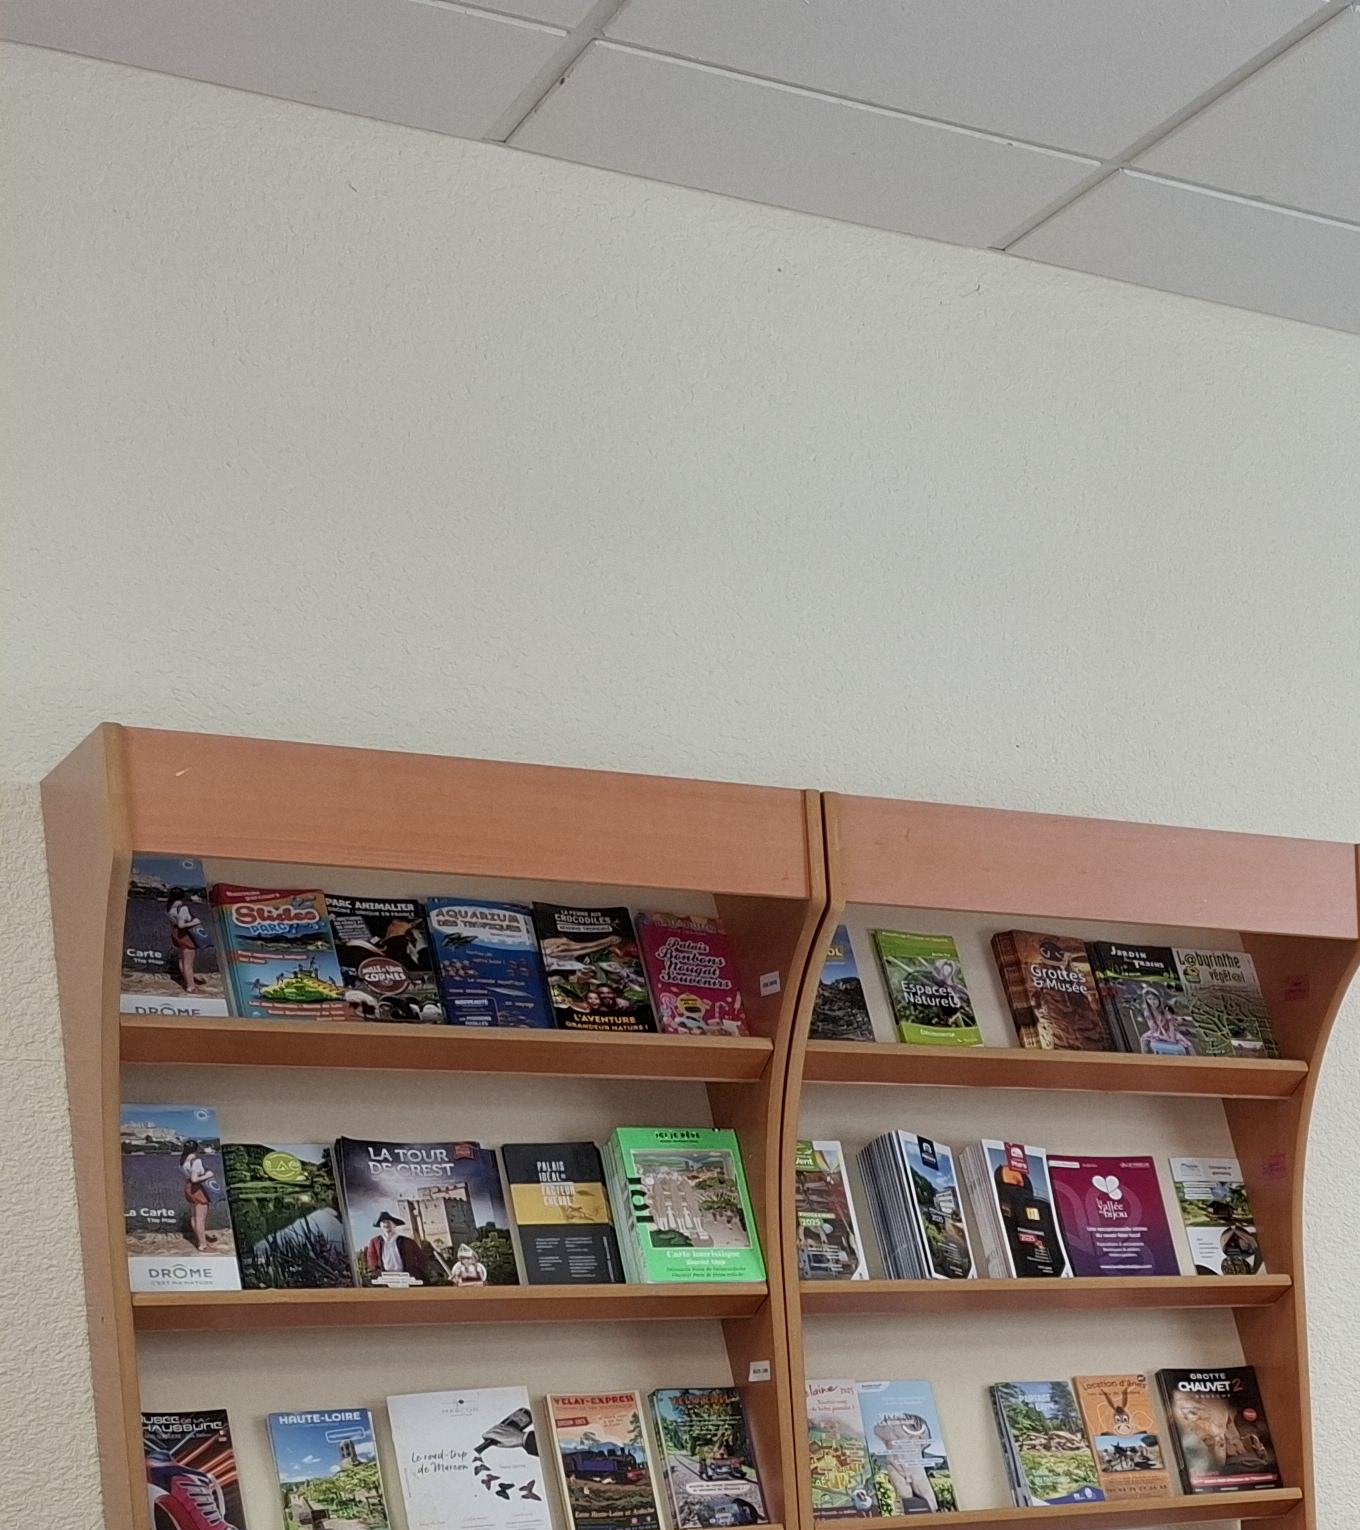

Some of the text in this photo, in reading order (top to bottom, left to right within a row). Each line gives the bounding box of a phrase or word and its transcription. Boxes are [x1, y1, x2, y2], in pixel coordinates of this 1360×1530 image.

[326, 898, 415, 912] PARC ANIMALIER
[234, 905, 319, 925] Slides
[435, 908, 521, 925] AQUARIUM
[554, 913, 612, 925] CROCODILES
[250, 923, 288, 935] PARC
[665, 937, 710, 954] Palais
[1110, 945, 1148, 960] JARDIN
[126, 948, 163, 959] Carte
[655, 948, 726, 968] Bonbons
[1177, 950, 1241, 970] L@byrinthe
[664, 960, 720, 977] Nougat
[1030, 964, 1087, 983] Grottes
[364, 970, 407, 983] CORNES
[660, 971, 732, 990] Souvenirs
[901, 980, 955, 996] Espaces
[1046, 979, 1088, 993] Musée
[904, 991, 961, 1008] Naturels
[573, 1013, 637, 1024] L'AVENTURE
[367, 1146, 450, 1163] LA TOUR
[368, 1161, 455, 1177] DE CREST
[536, 1161, 565, 1173] PALAIS
[542, 1195, 574, 1207] CHEVAL
[140, 1207, 176, 1217] Carte
[800, 1218, 821, 1226] 2025
[148, 1263, 213, 1279] DRÔME
[1081, 1380, 1117, 1391] Location
[1177, 1378, 1244, 1392] CHAUVET 2
[278, 1411, 362, 1425] HAUTE-LOIRE
[411, 1451, 423, 1462] Le
[417, 1464, 430, 1474] de
